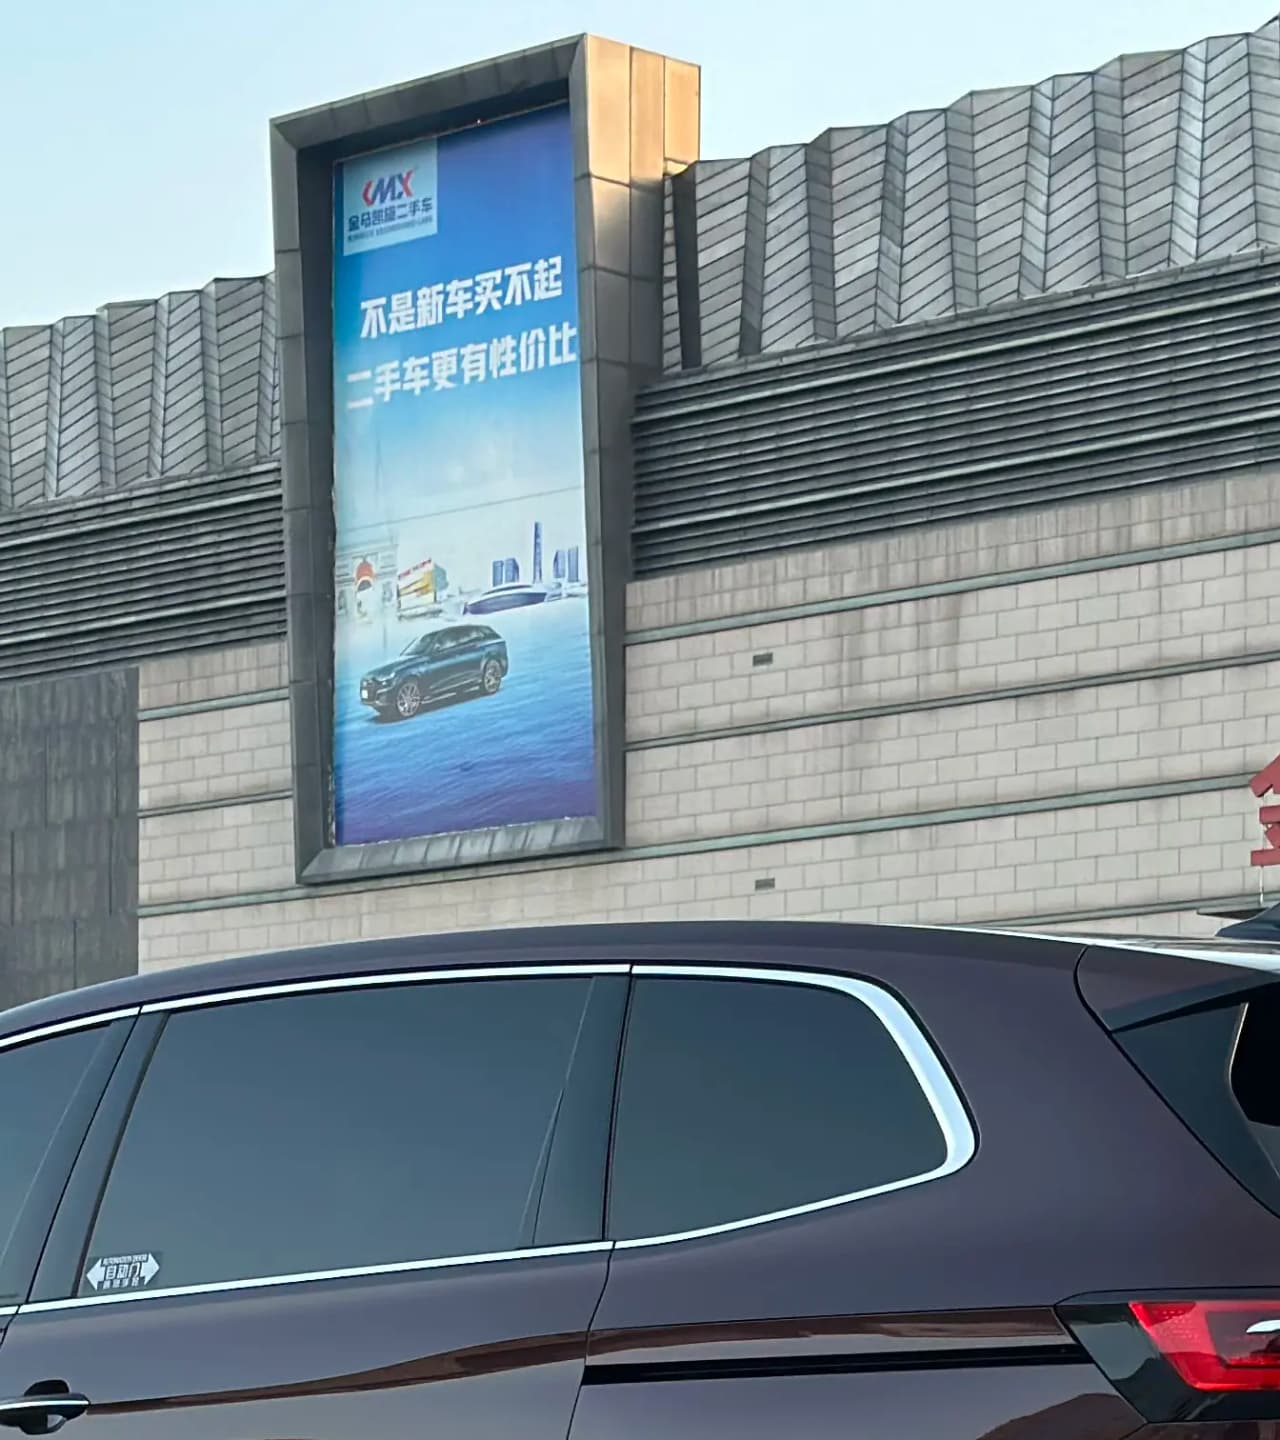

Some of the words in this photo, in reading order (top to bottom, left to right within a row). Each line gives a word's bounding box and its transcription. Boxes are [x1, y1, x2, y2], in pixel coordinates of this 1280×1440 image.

[360, 255, 562, 339] 不是新车买不起
[346, 321, 577, 410] 二手车更有性价比
